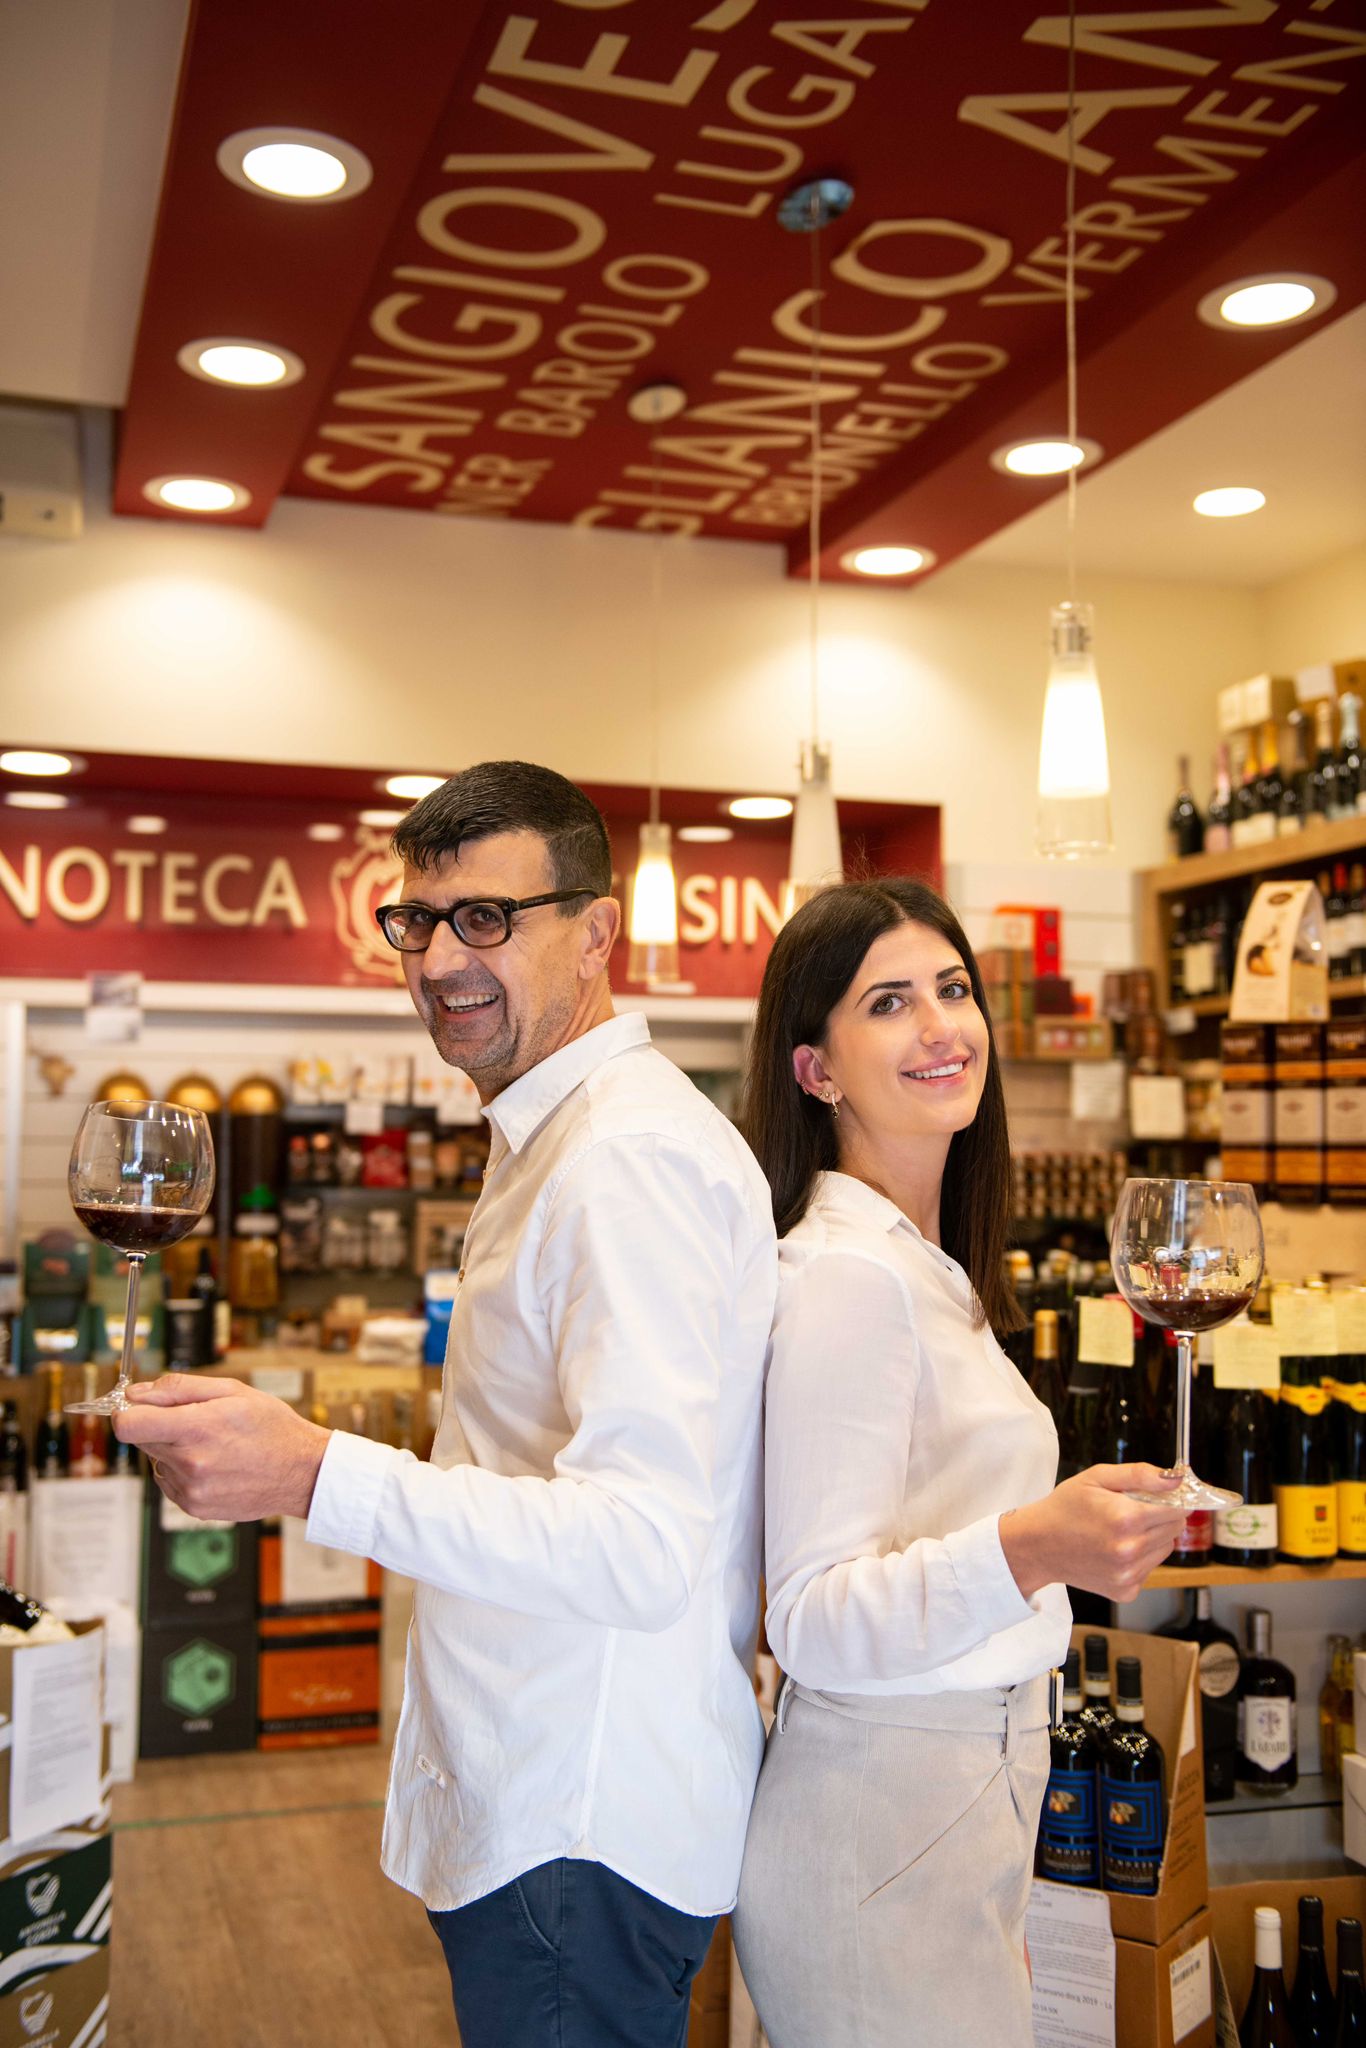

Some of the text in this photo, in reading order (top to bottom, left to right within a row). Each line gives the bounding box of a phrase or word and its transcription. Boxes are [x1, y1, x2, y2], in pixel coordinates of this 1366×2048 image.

[303, 0, 757, 493] SANGIOVE
[494, 253, 710, 439] BAROLO
[654, 0, 932, 218] LUGA
[730, 0, 1366, 528] BRUNELLO VERMEN
